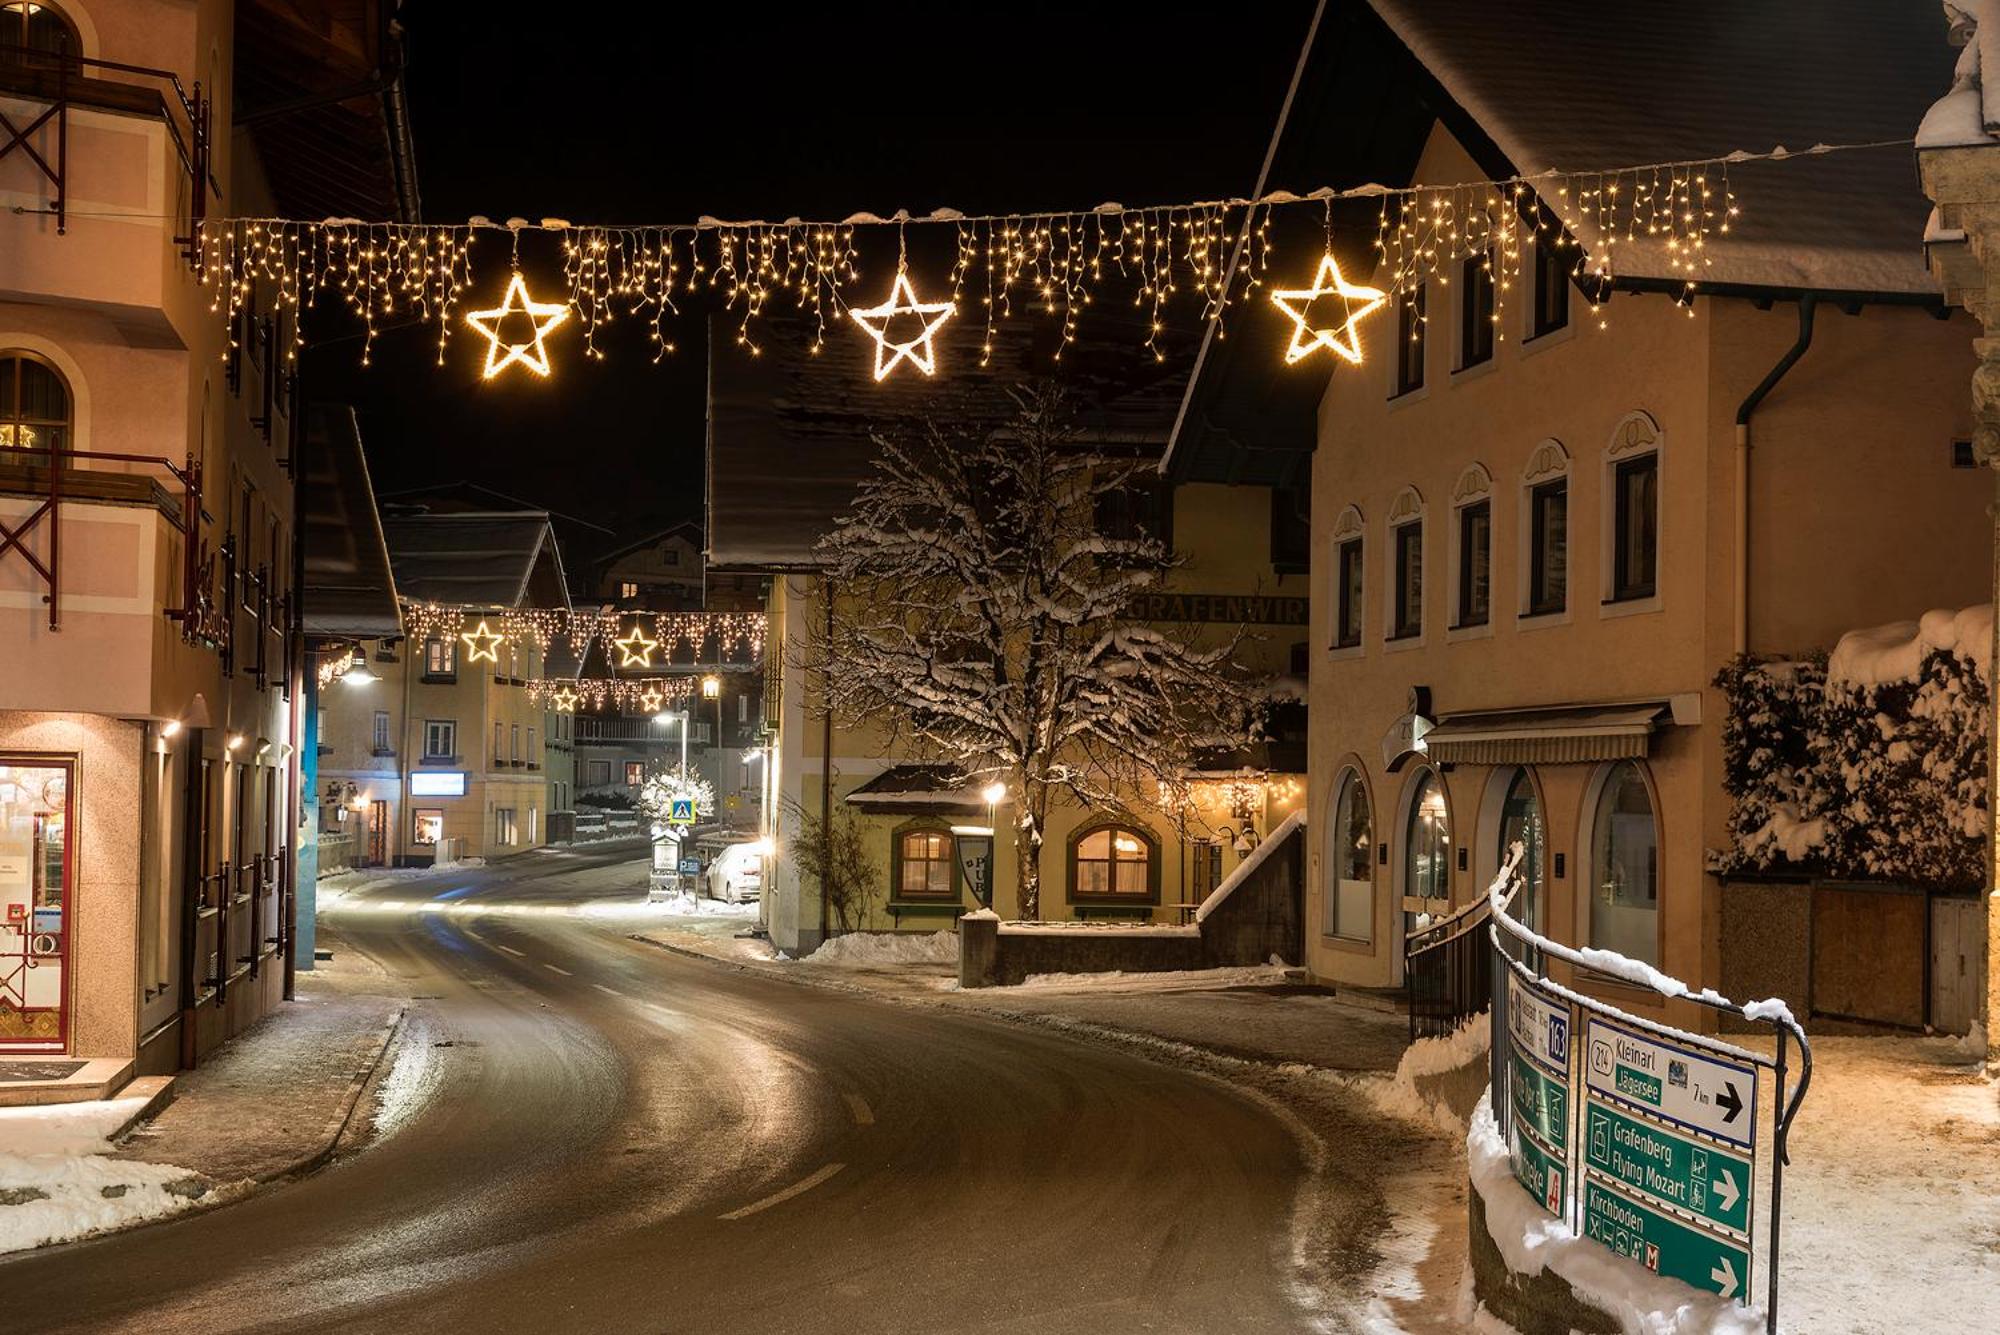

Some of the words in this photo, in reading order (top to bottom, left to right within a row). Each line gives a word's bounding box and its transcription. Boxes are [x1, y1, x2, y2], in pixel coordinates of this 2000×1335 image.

[1550, 1020, 1566, 1057] 163
[1616, 1038, 1656, 1071] Kleinarl
[1596, 1046, 1609, 1069] 214
[1618, 1069, 1659, 1100] Jägersee
[1614, 1121, 1672, 1168] Grafenberg
[1612, 1150, 1643, 1186] Flying
[1645, 1165, 1685, 1201] Mozart
[1590, 1187, 1644, 1234] Kirchboden
